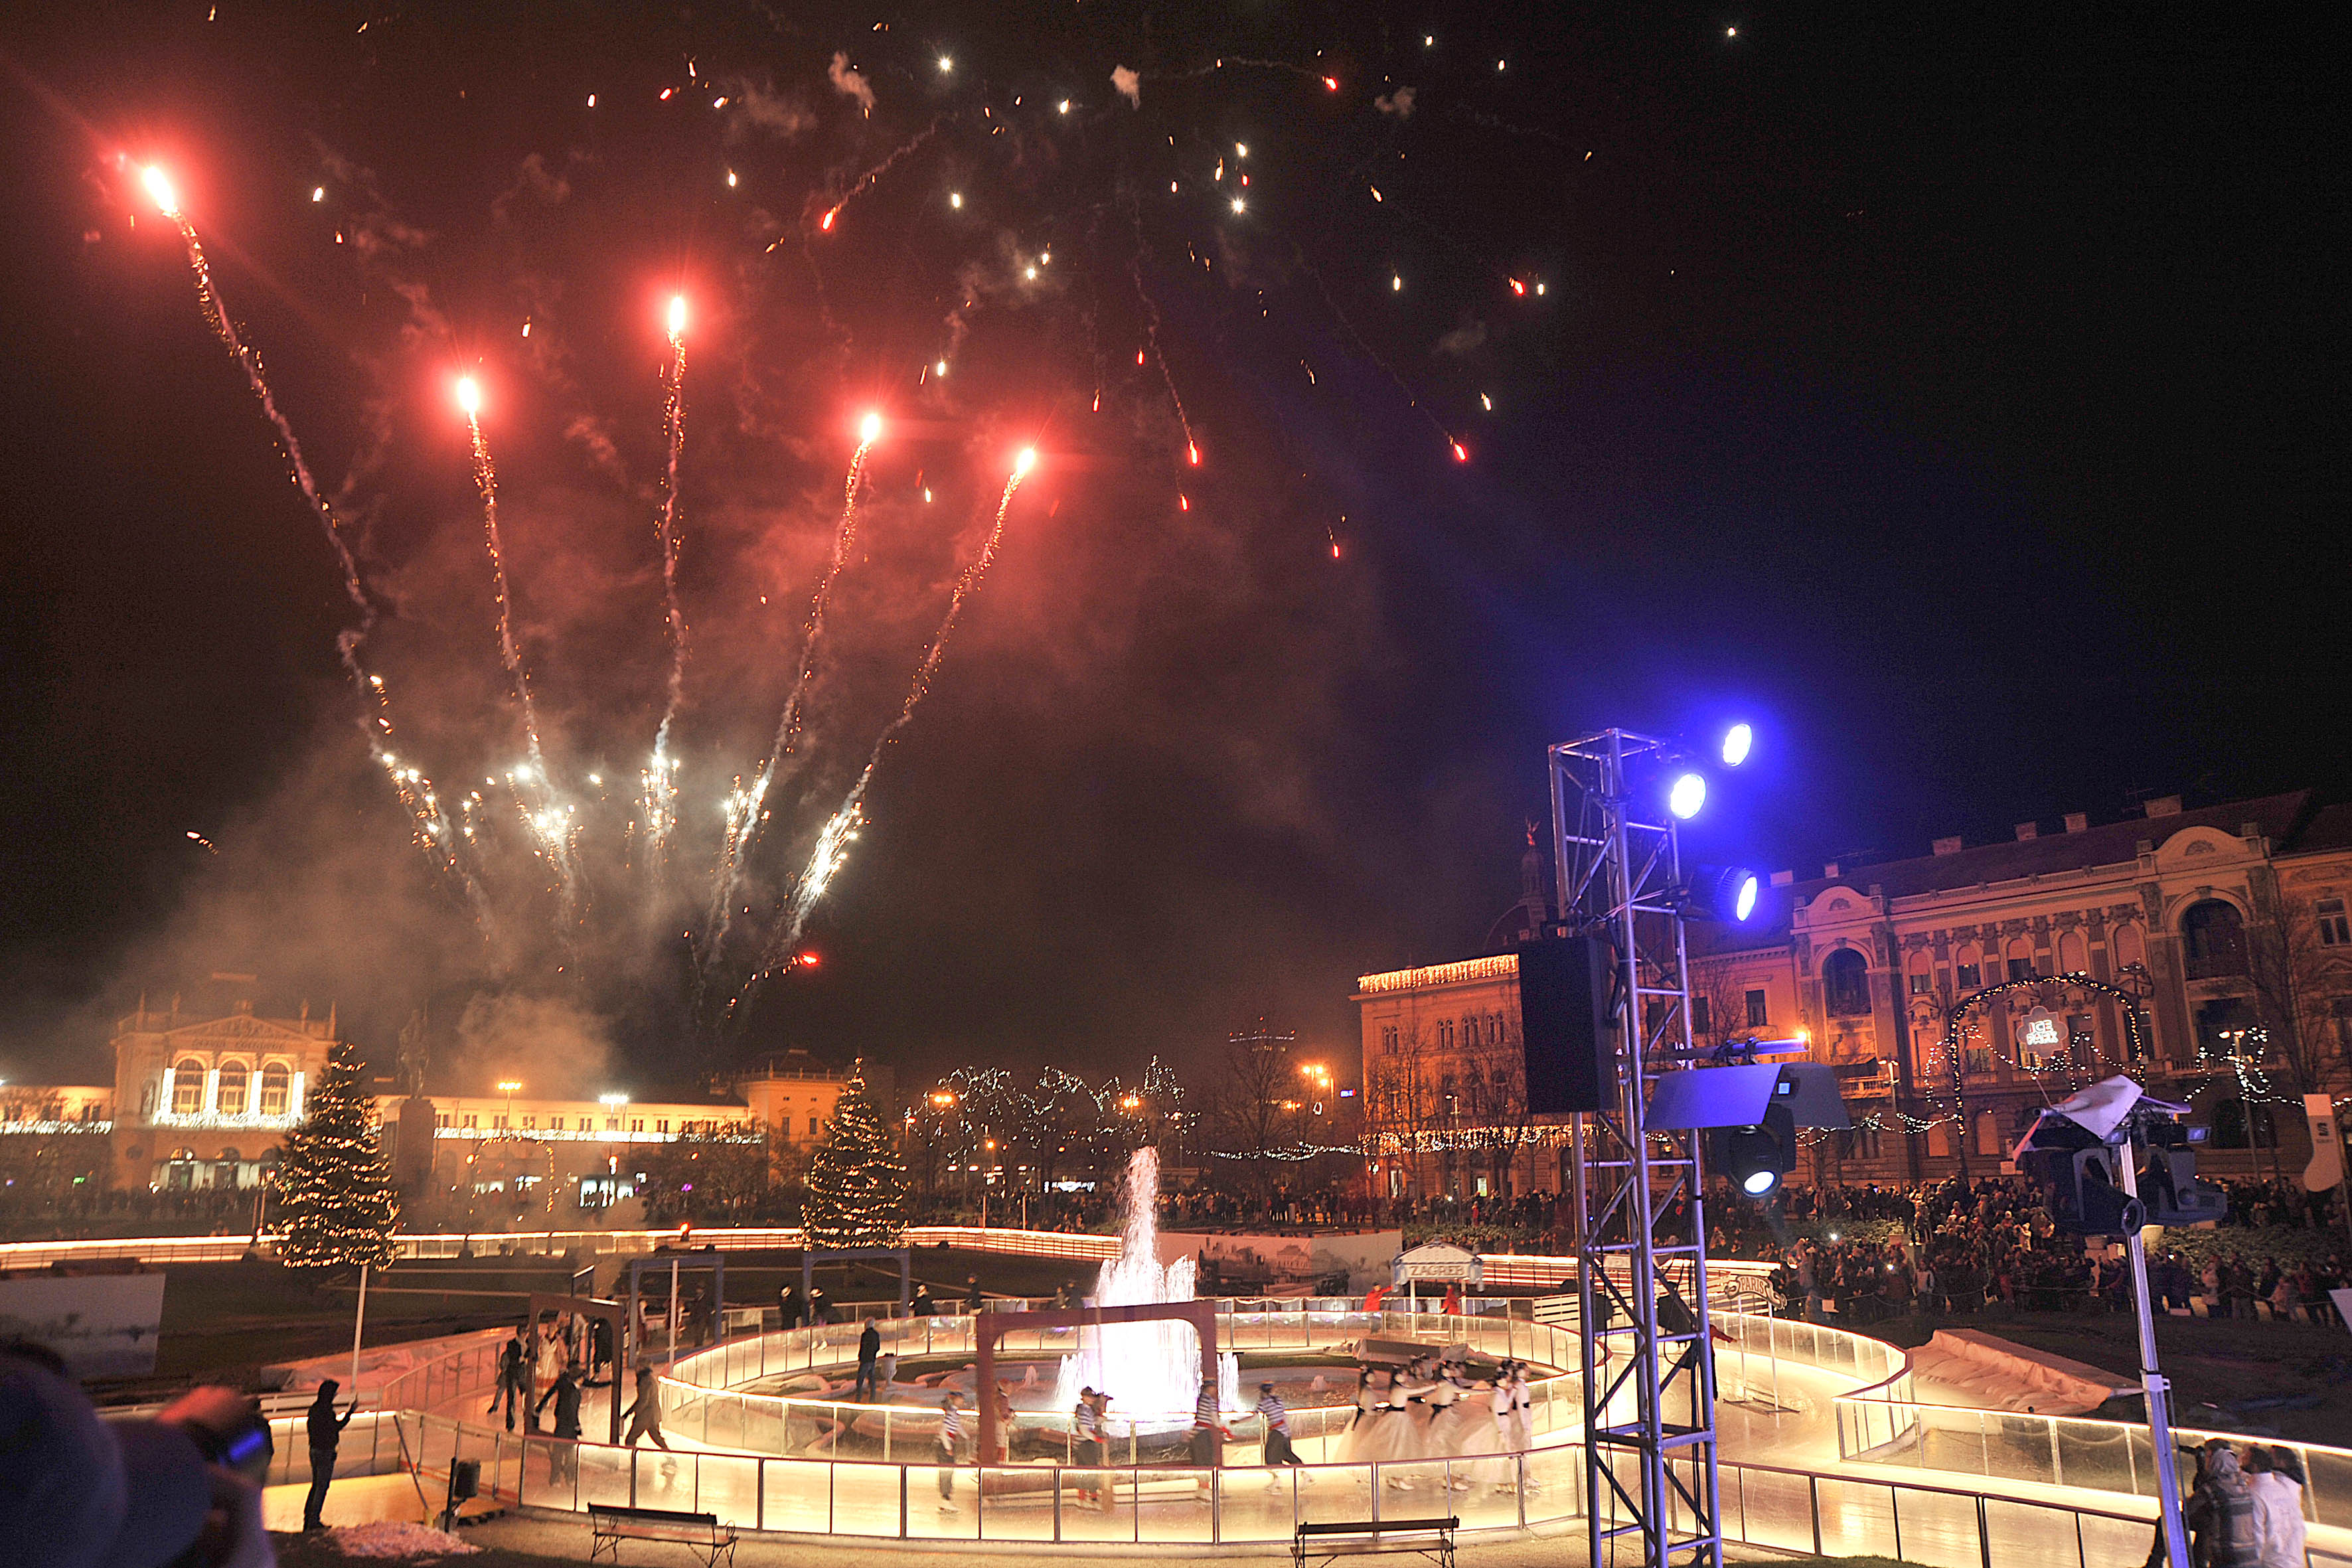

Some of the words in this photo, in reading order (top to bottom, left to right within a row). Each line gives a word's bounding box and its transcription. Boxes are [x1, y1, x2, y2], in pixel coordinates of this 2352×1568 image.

[2029, 1020, 2053, 1033] ICE
[2027, 1031, 2058, 1045] PARK
[1409, 1265, 1464, 1275] ZAGREB
[1741, 1277, 1764, 1294] PARIS
